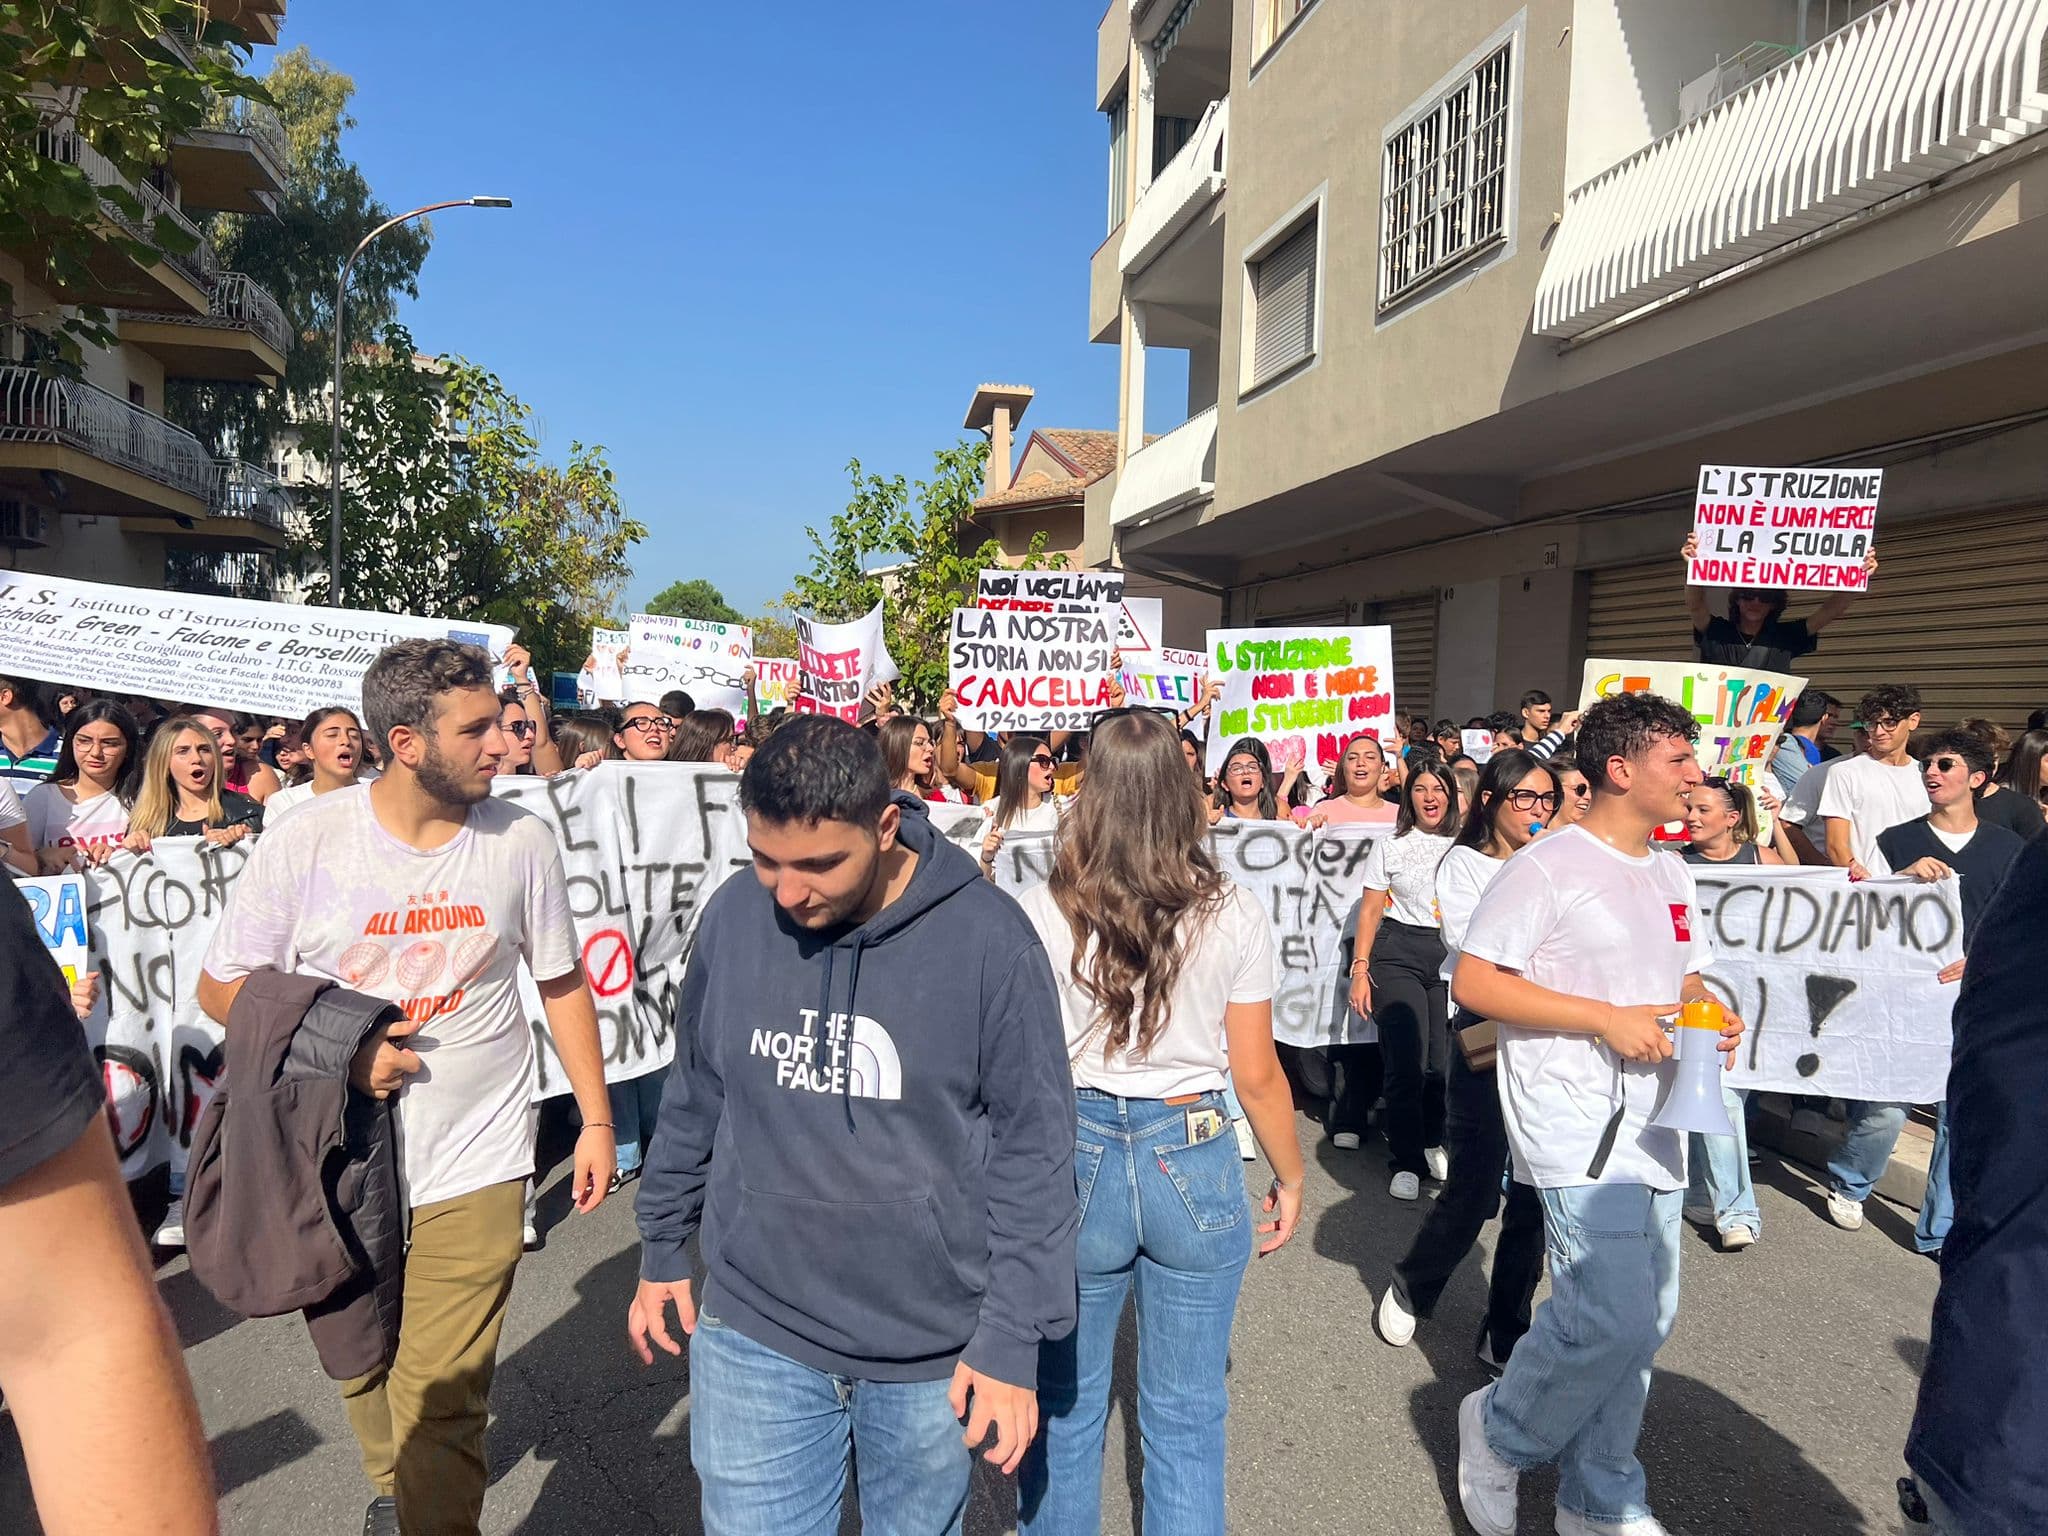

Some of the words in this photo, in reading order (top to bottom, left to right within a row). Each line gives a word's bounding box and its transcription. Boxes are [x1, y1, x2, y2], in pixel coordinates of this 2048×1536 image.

[1701, 468, 1880, 500] L'ISTRUZIONE
[1697, 503, 1745, 525] NON
[1749, 499, 1767, 527] È
[1771, 506, 1818, 528] UNA
[1821, 505, 1876, 530] MERCE
[1715, 528, 1755, 554] LA
[1772, 532, 1867, 558] SCUOLA
[1692, 559, 1738, 583] NON
[1741, 557, 1757, 584] È
[979, 574, 1019, 596] NOI
[1026, 574, 1125, 603] VOGLIAMO
[69, 597, 151, 617] Istituto
[75, 615, 143, 637] Green
[166, 626, 251, 649] Falcone
[255, 640, 273, 652] e
[278, 638, 377, 665] Borsellin
[685, 620, 727, 636] QUESTO
[741, 626, 749, 638] A
[956, 612, 997, 639] LA
[1008, 614, 1109, 643] NOSTRA
[133, 640, 204, 659] Corigliano
[207, 648, 263, 667] Calabro
[953, 641, 1029, 672] STORIA
[1038, 650, 1082, 672] NON
[1084, 649, 1107, 673] SI
[195, 662, 228, 677] Codice
[956, 674, 1112, 708] CANCELLA
[1116, 671, 1200, 705] MATECI
[1252, 672, 1296, 701] NON
[1348, 691, 1391, 721] NON
[364, 911, 398, 936] ALL
[403, 905, 486, 935] AROUND
[799, 1008, 848, 1041] THE
[776, 1060, 845, 1095] FACE
